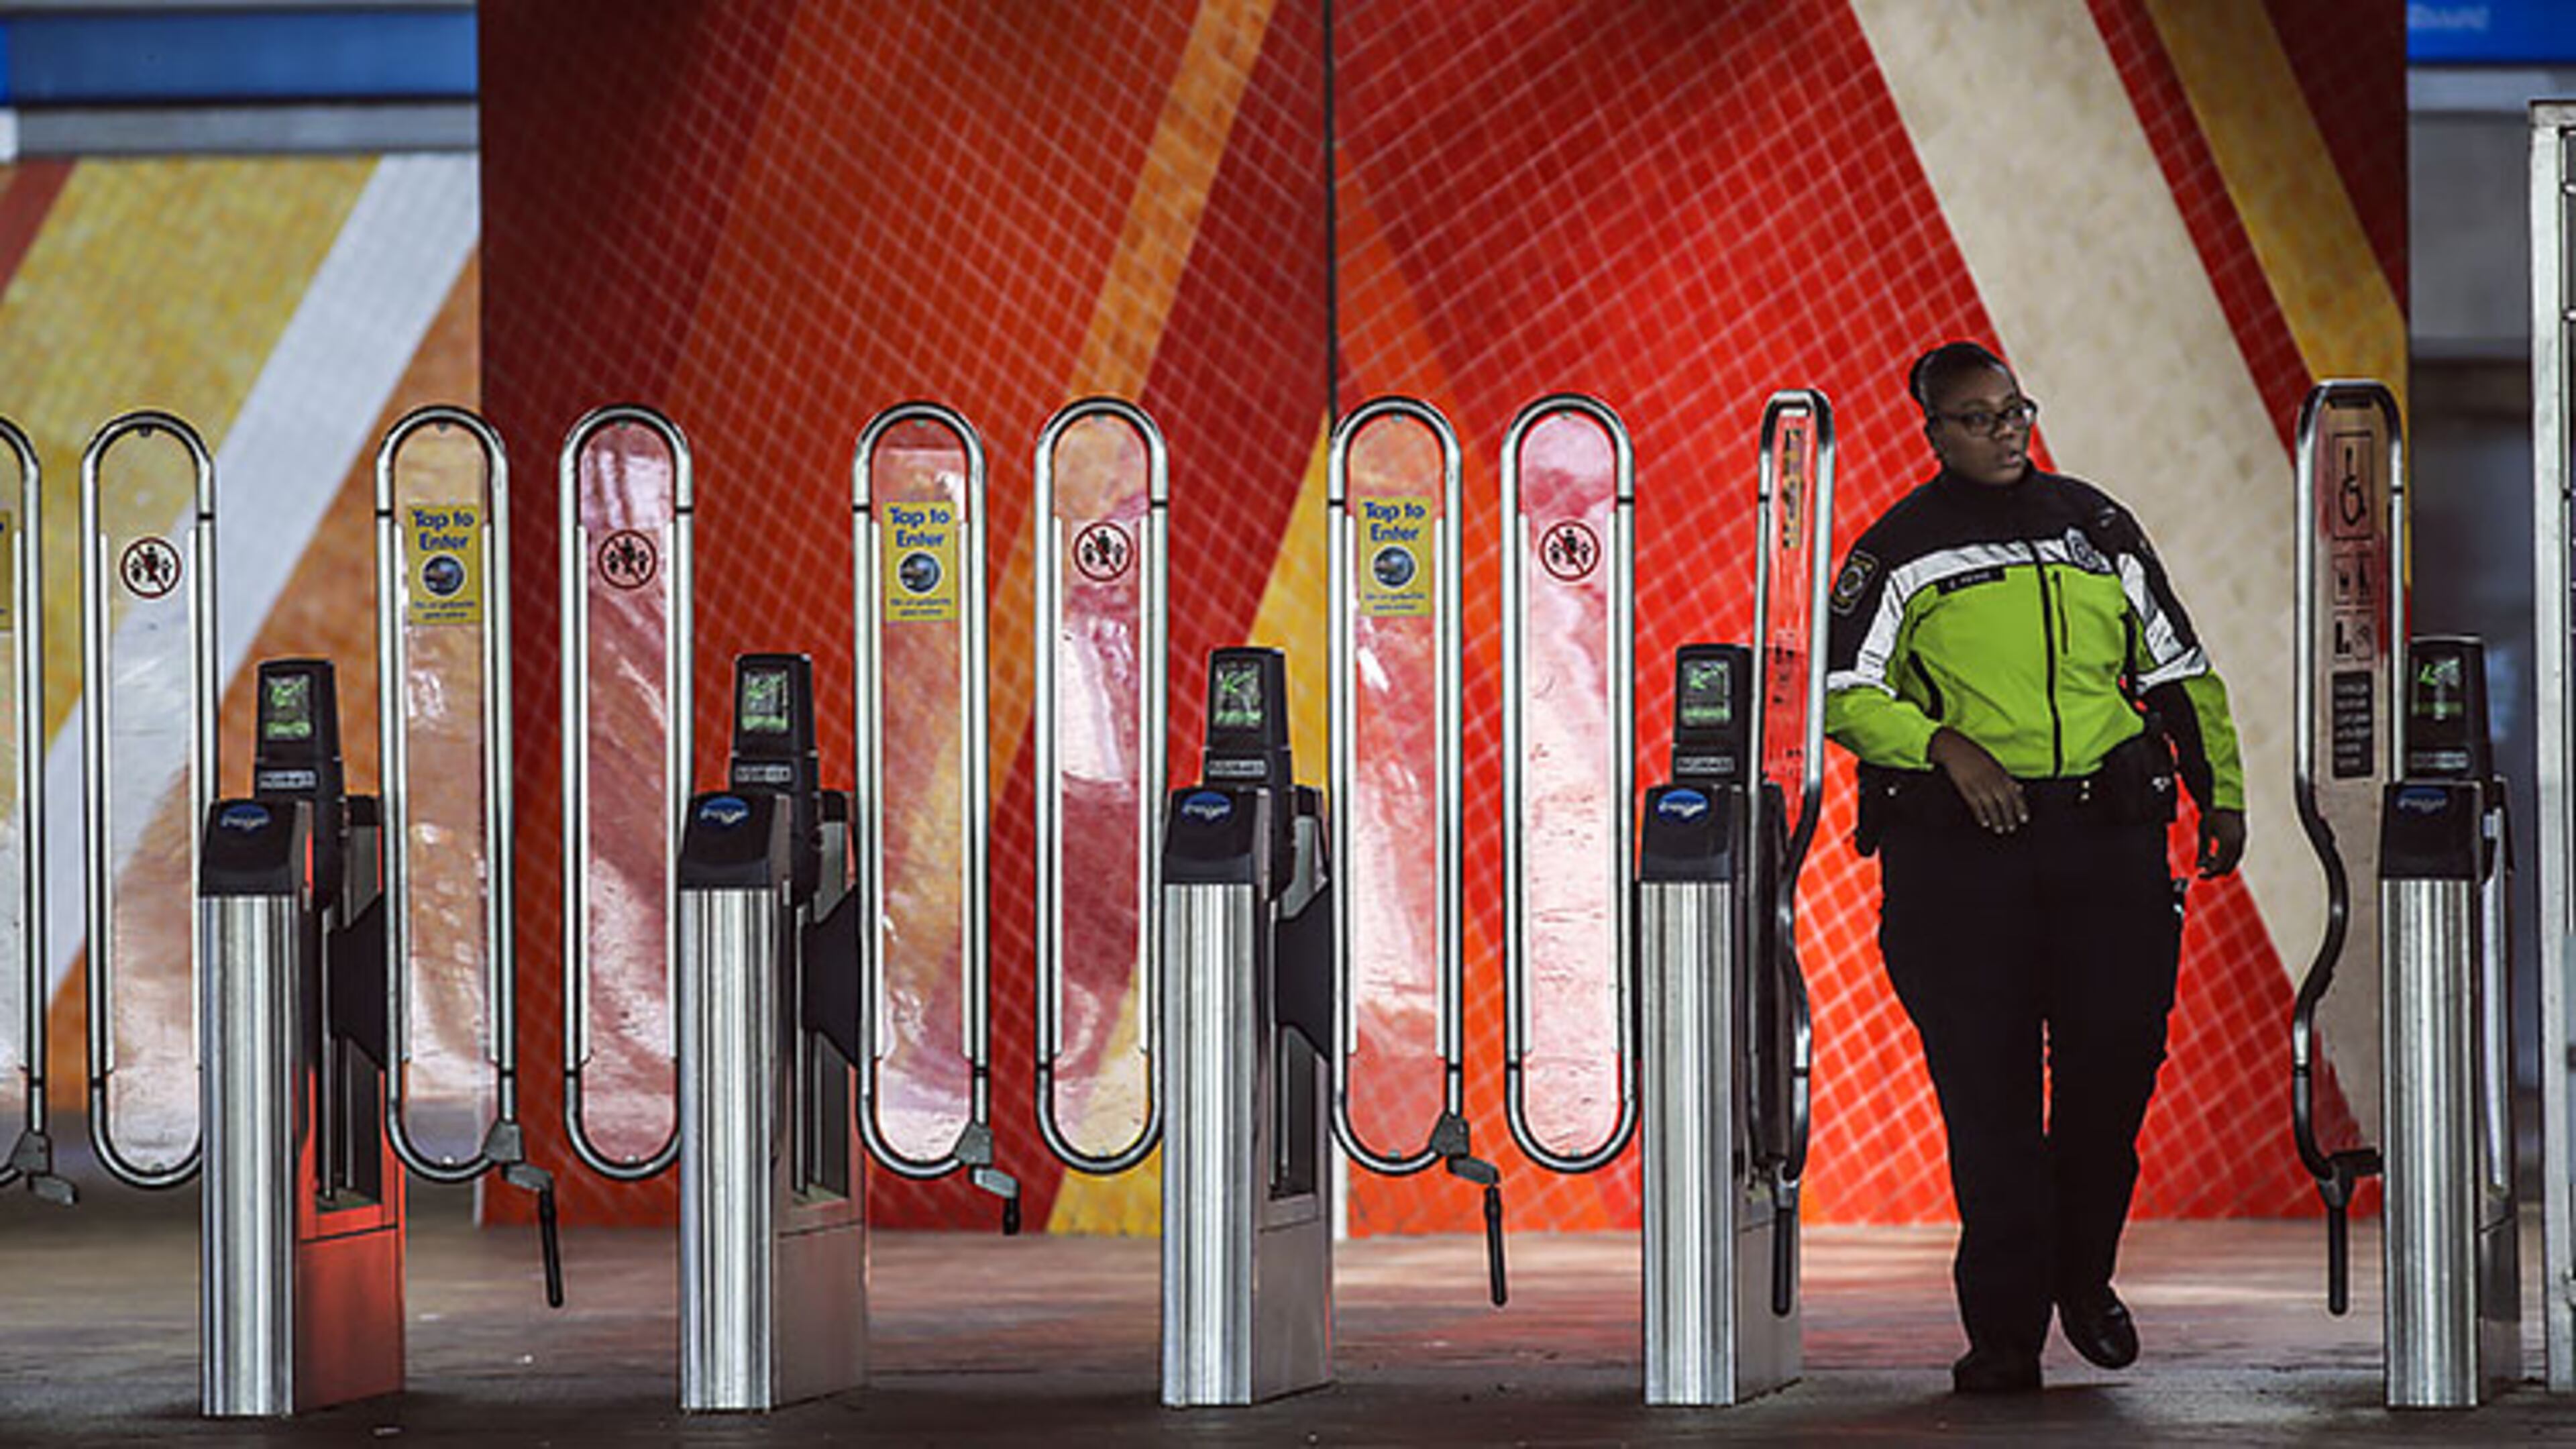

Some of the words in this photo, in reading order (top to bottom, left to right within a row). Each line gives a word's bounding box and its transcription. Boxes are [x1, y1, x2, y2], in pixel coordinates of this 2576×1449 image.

[413, 509, 449, 531] Tap
[453, 511, 475, 527] to
[889, 506, 925, 529] Tap
[930, 508, 951, 525] to
[1363, 502, 1400, 522] Tap
[1404, 503, 1426, 519] to
[896, 529, 946, 547] Enter
[1370, 523, 1419, 541] Enter
[418, 533, 470, 551] Enter
